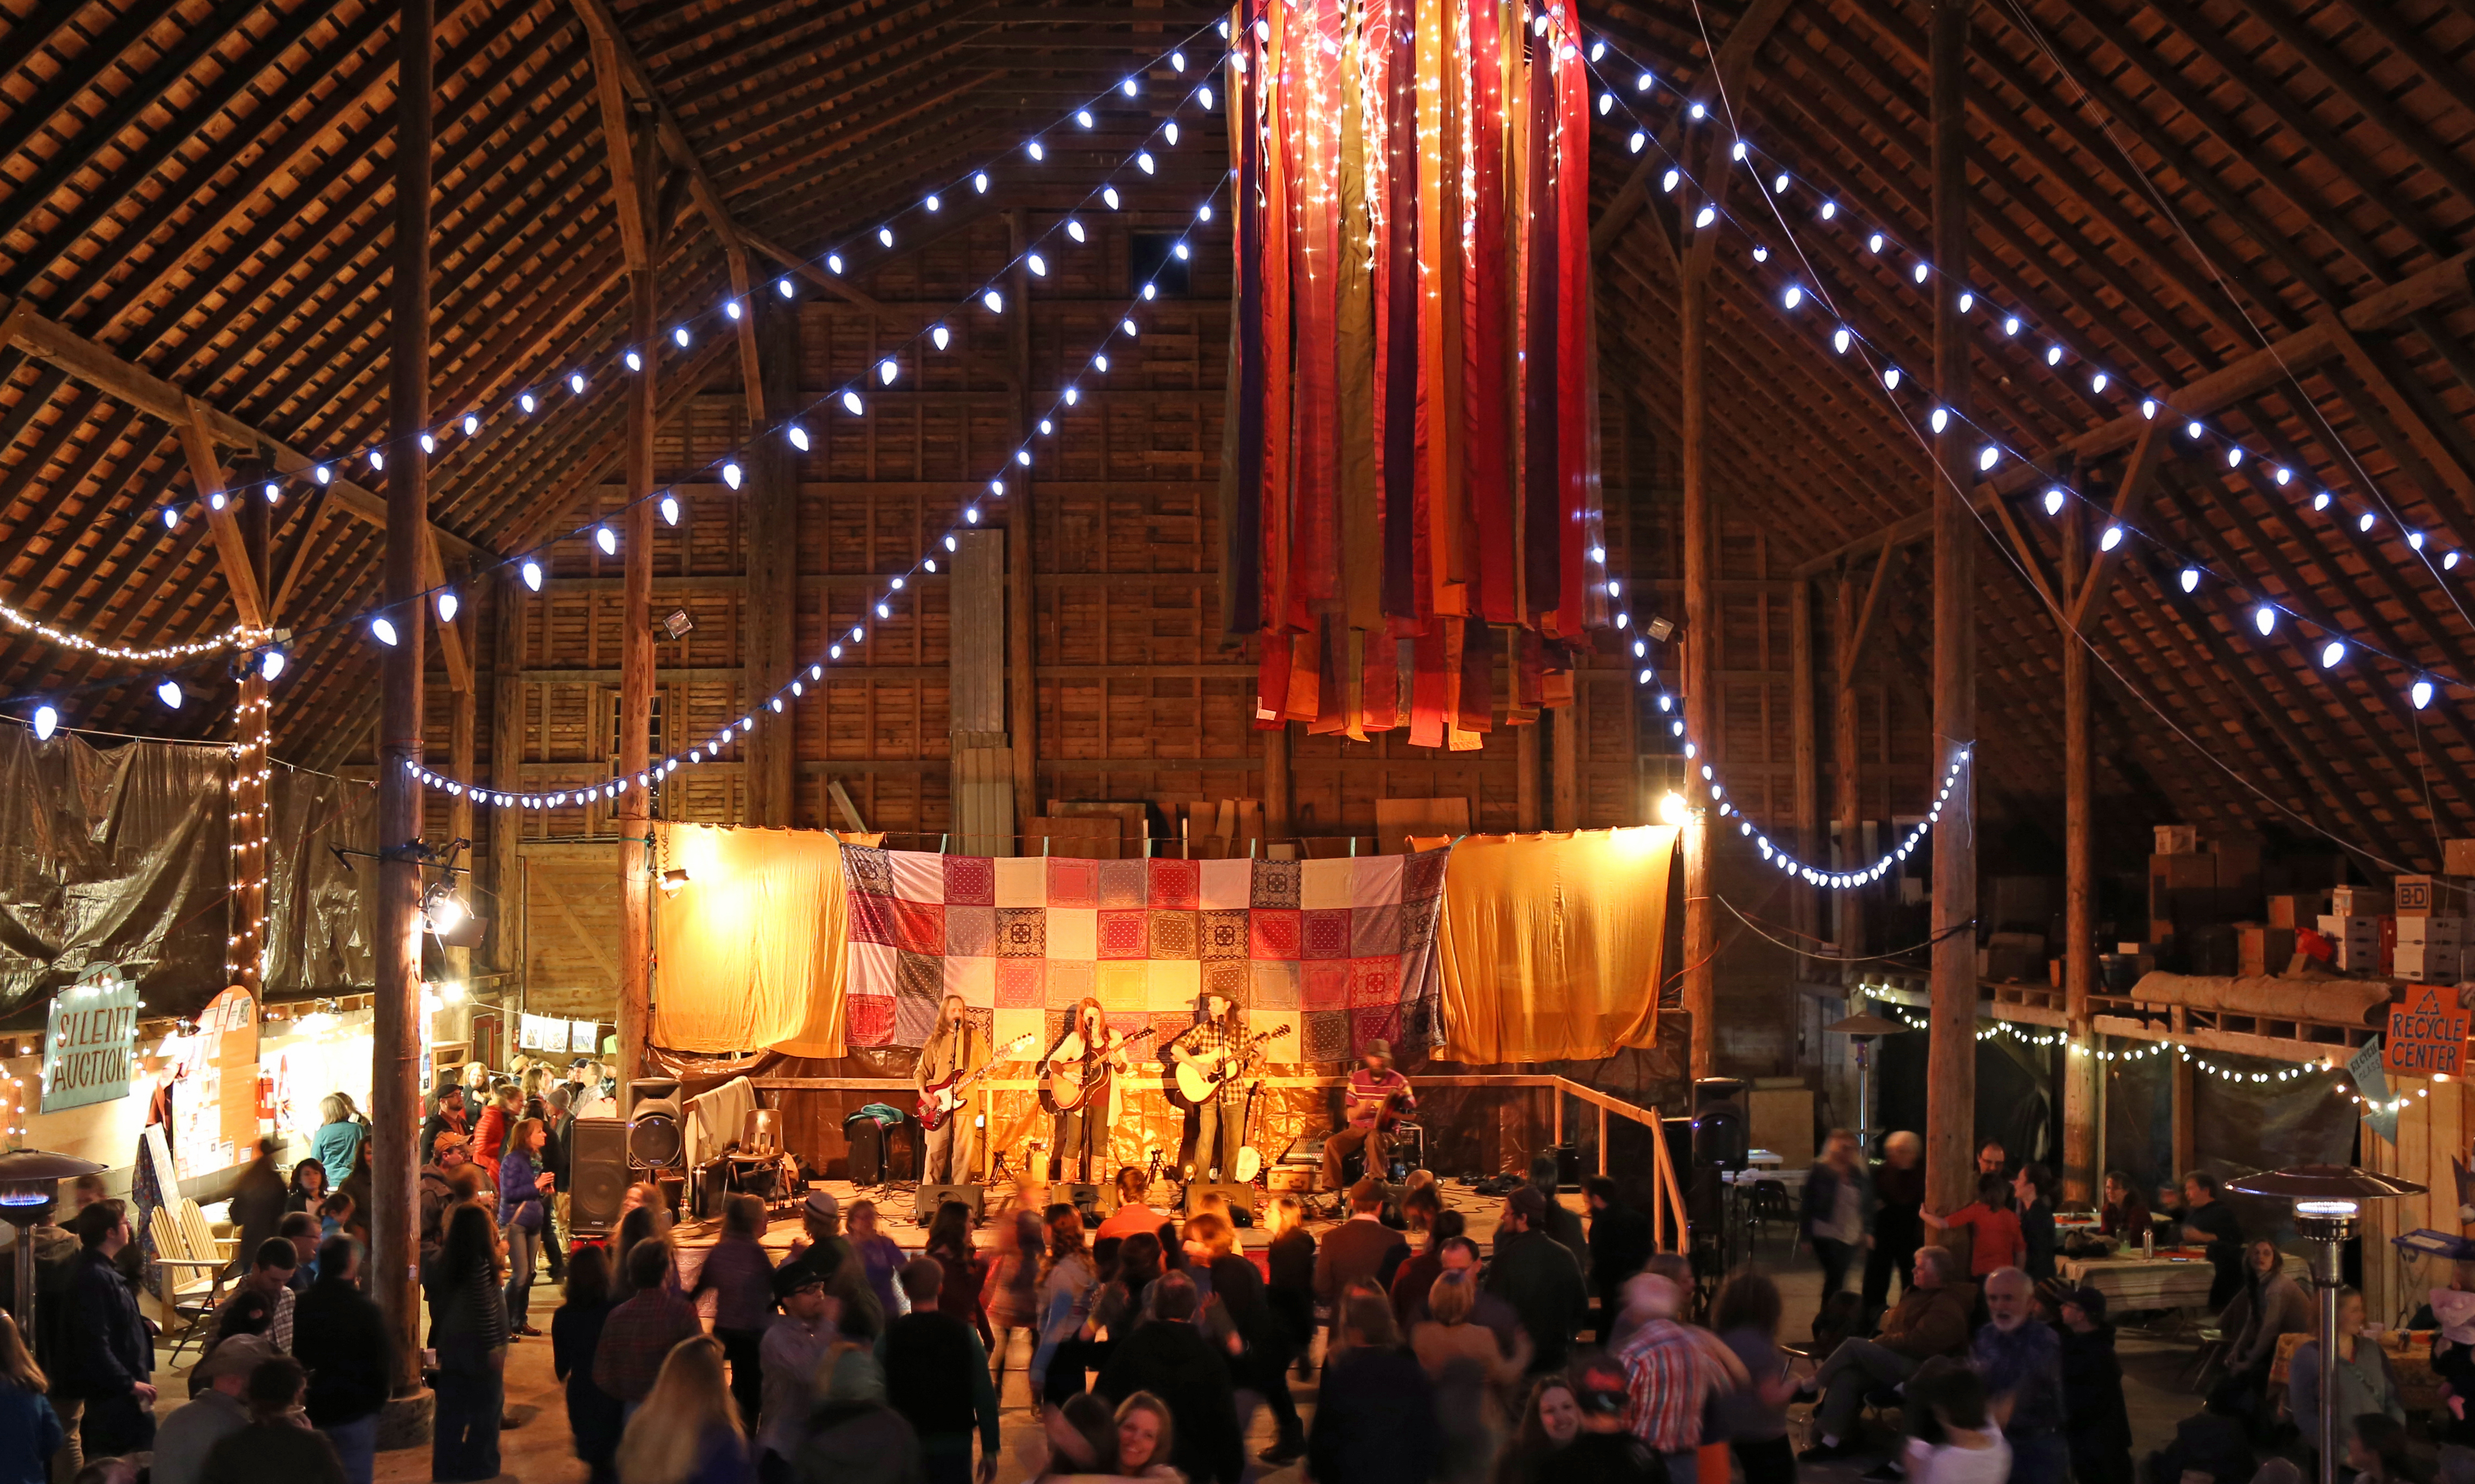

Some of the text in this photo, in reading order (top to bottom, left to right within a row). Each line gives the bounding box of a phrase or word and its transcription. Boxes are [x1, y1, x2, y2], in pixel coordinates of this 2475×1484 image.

[57, 1006, 132, 1049] SILENT
[2392, 1013, 2464, 1042] RECYCLE
[52, 1046, 128, 1093] AUCTION
[2392, 1041, 2457, 1072] CENTER
